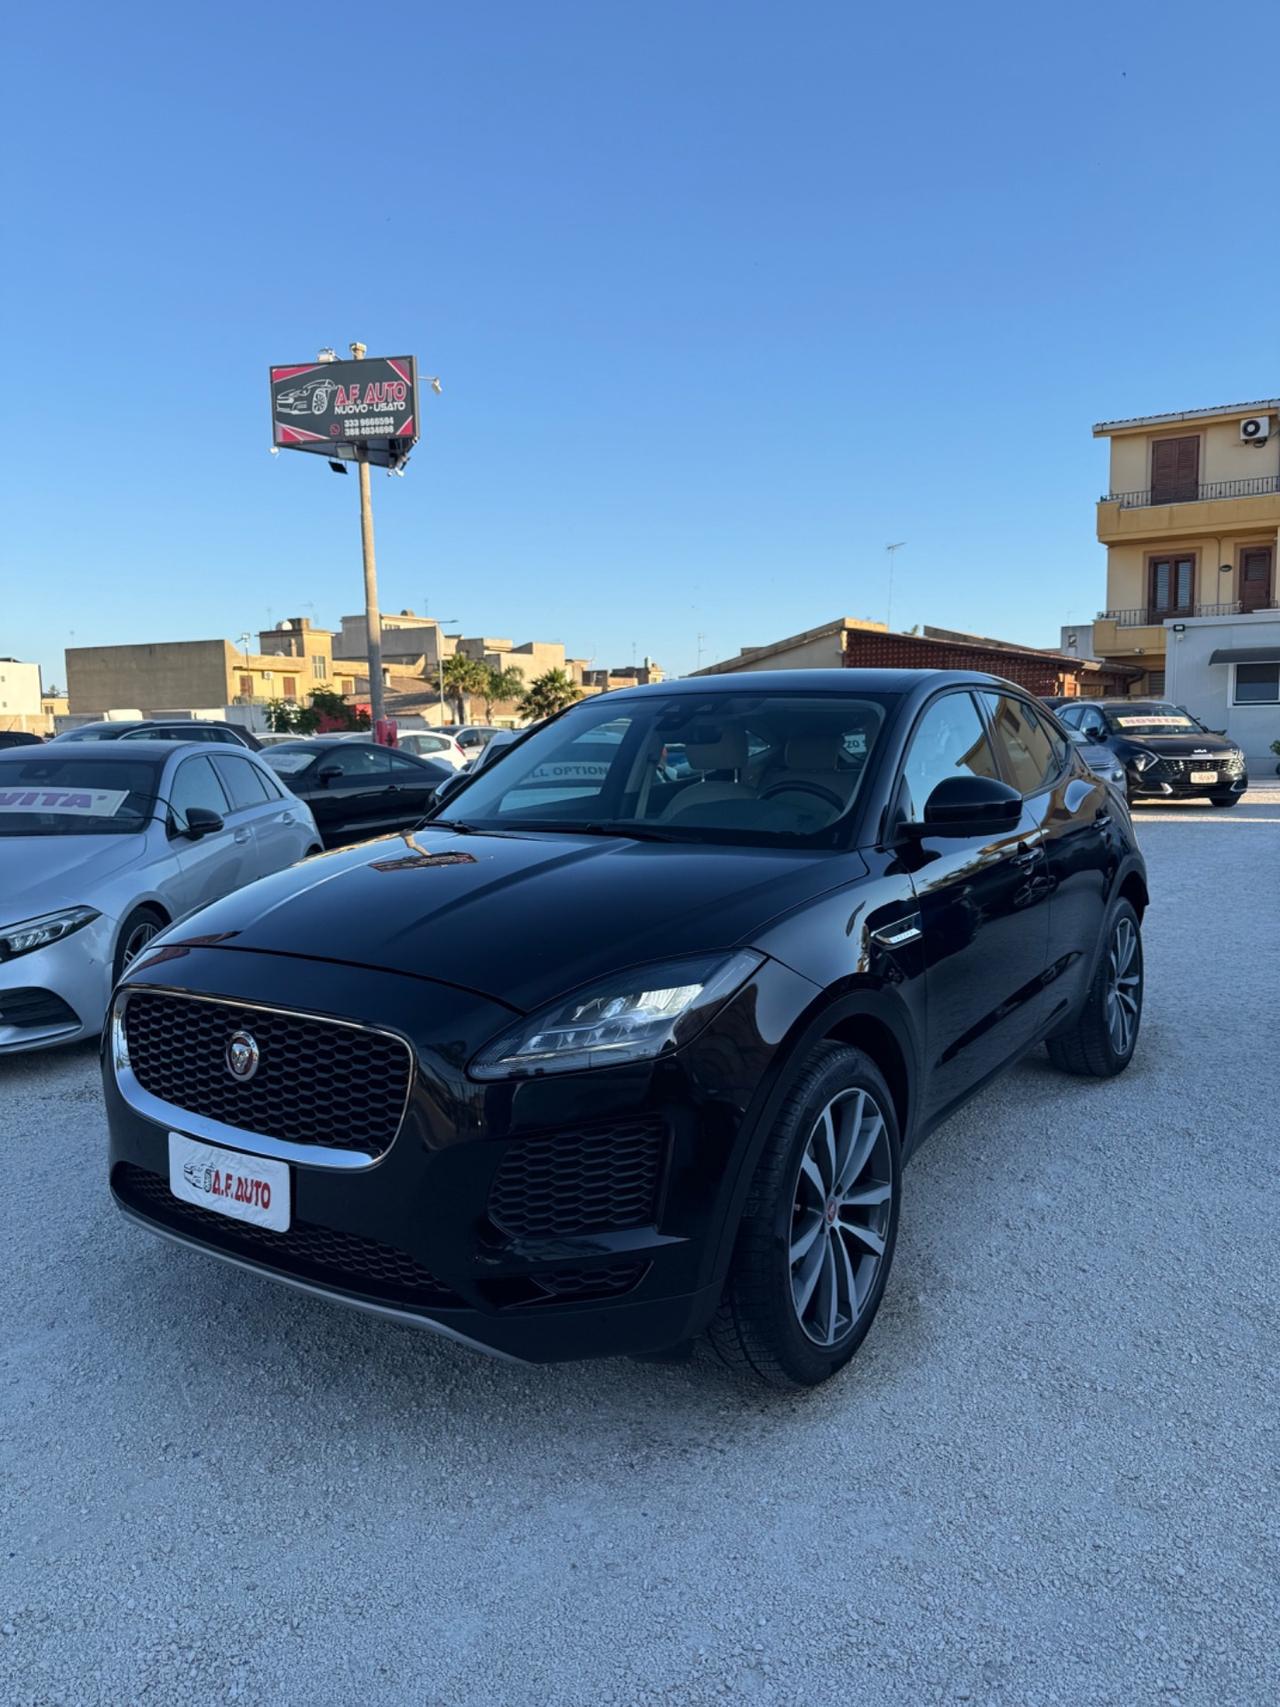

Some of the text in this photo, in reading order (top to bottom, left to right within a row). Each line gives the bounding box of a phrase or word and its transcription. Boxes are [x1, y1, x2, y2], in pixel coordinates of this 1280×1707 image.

[335, 381, 407, 406] A.F. AUTO
[335, 404, 368, 415] NUOVO
[373, 402, 406, 412] USATO
